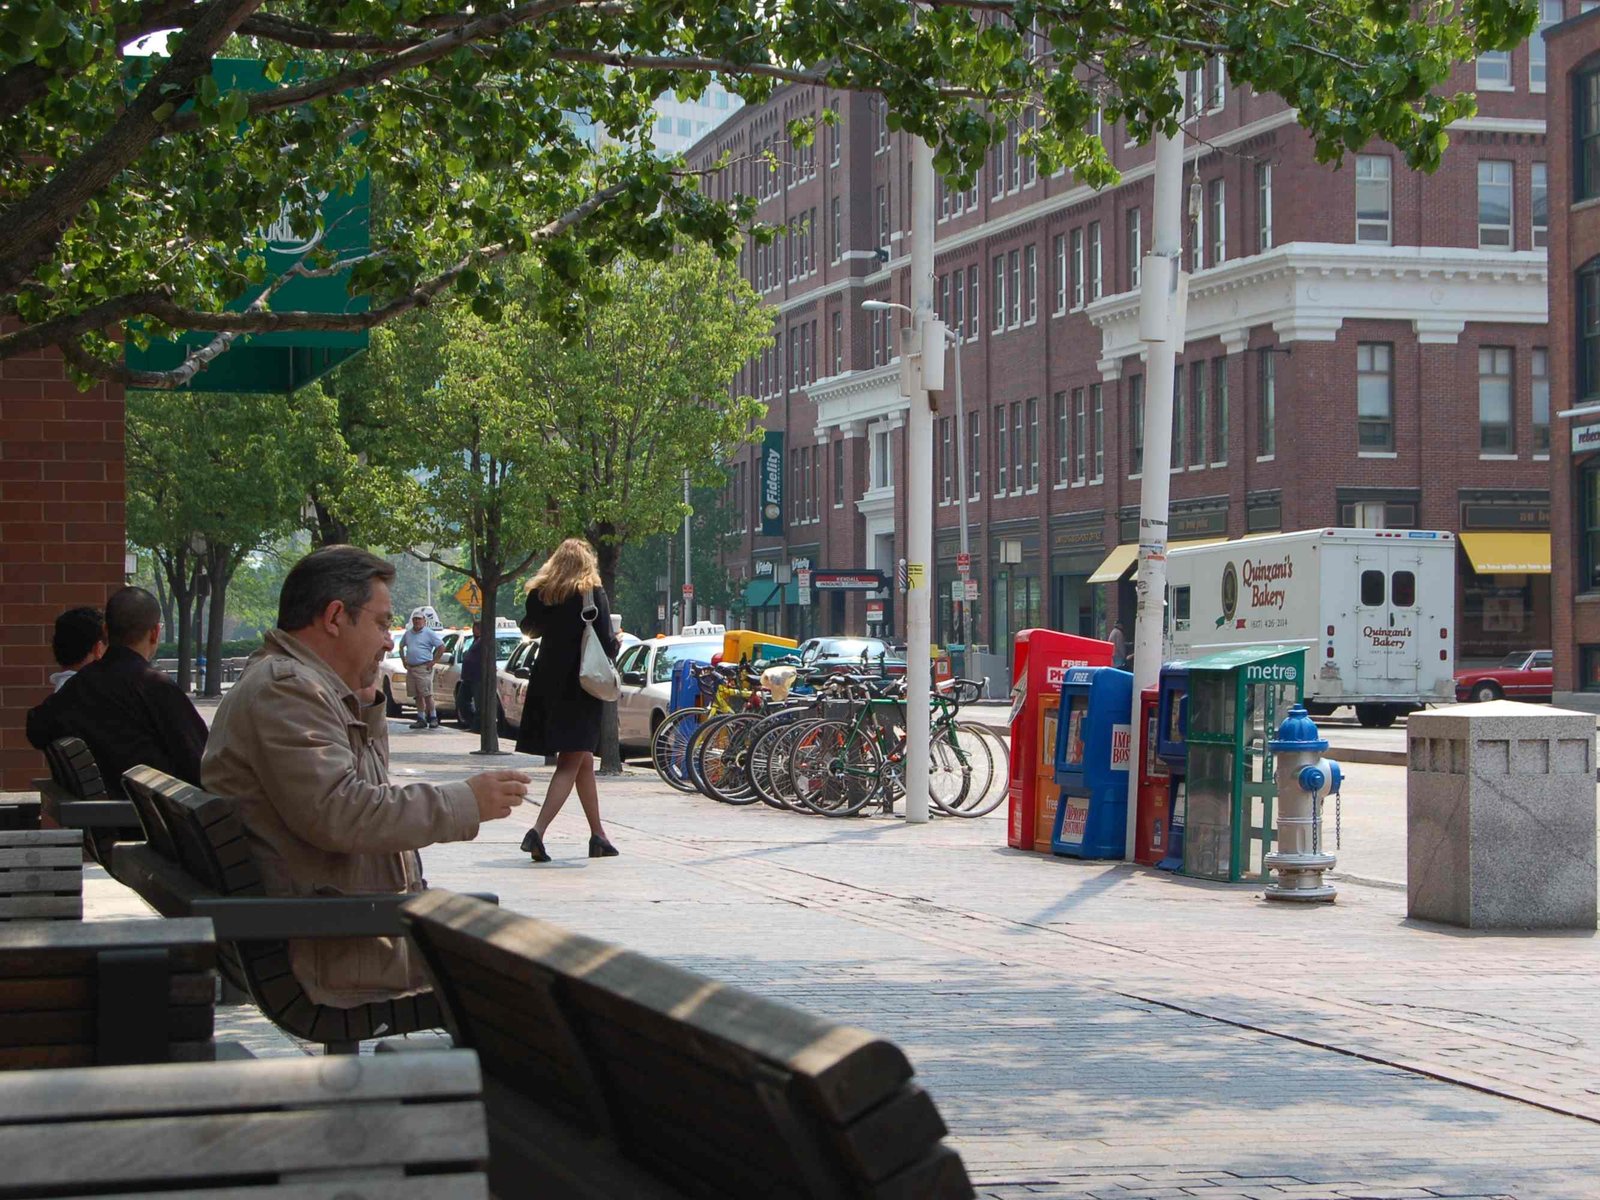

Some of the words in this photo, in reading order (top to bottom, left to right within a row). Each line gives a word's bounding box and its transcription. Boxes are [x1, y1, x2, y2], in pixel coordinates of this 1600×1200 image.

[767, 448, 780, 504] Fidelity
[1242, 555, 1293, 587] Quinzani's
[1251, 584, 1285, 610] Bakery
[693, 627, 717, 635] TAXI
[1363, 626, 1412, 638] Quinzani's
[1372, 637, 1405, 649] Bakery
[1061, 659, 1088, 668] FREE
[1050, 669, 1064, 681] Ph
[1072, 672, 1089, 682] FREE
[1247, 664, 1297, 680] metro
[1113, 731, 1131, 748] IMP
[1113, 748, 1130, 764] BOS
